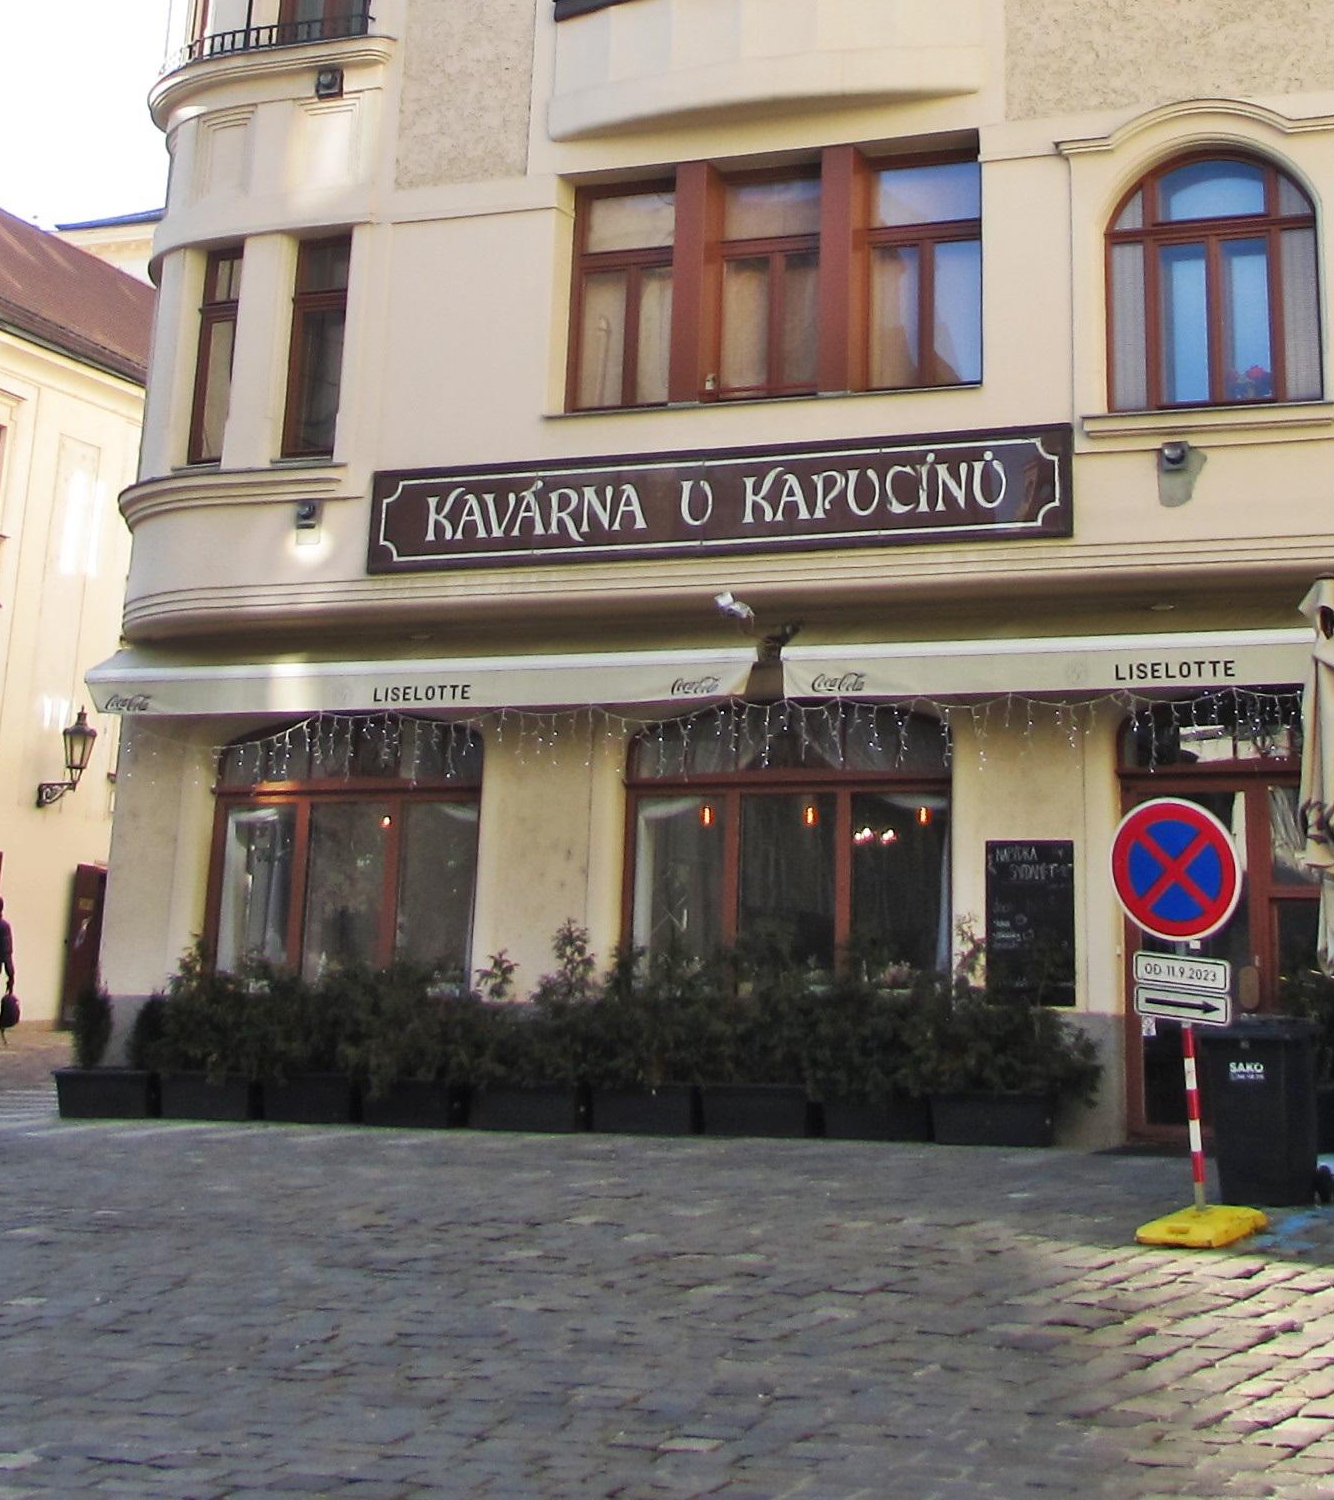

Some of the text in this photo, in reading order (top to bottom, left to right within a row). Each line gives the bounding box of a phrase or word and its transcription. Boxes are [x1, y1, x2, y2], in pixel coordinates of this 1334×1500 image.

[424, 450, 1007, 542] KAVÁRNA U KAPUCÍNŮ
[1115, 660, 1236, 681] LISELOTTE
[373, 684, 471, 703] LISELOTTE
[1144, 962, 1162, 976] OD
[1229, 1062, 1264, 1073] SAKO
